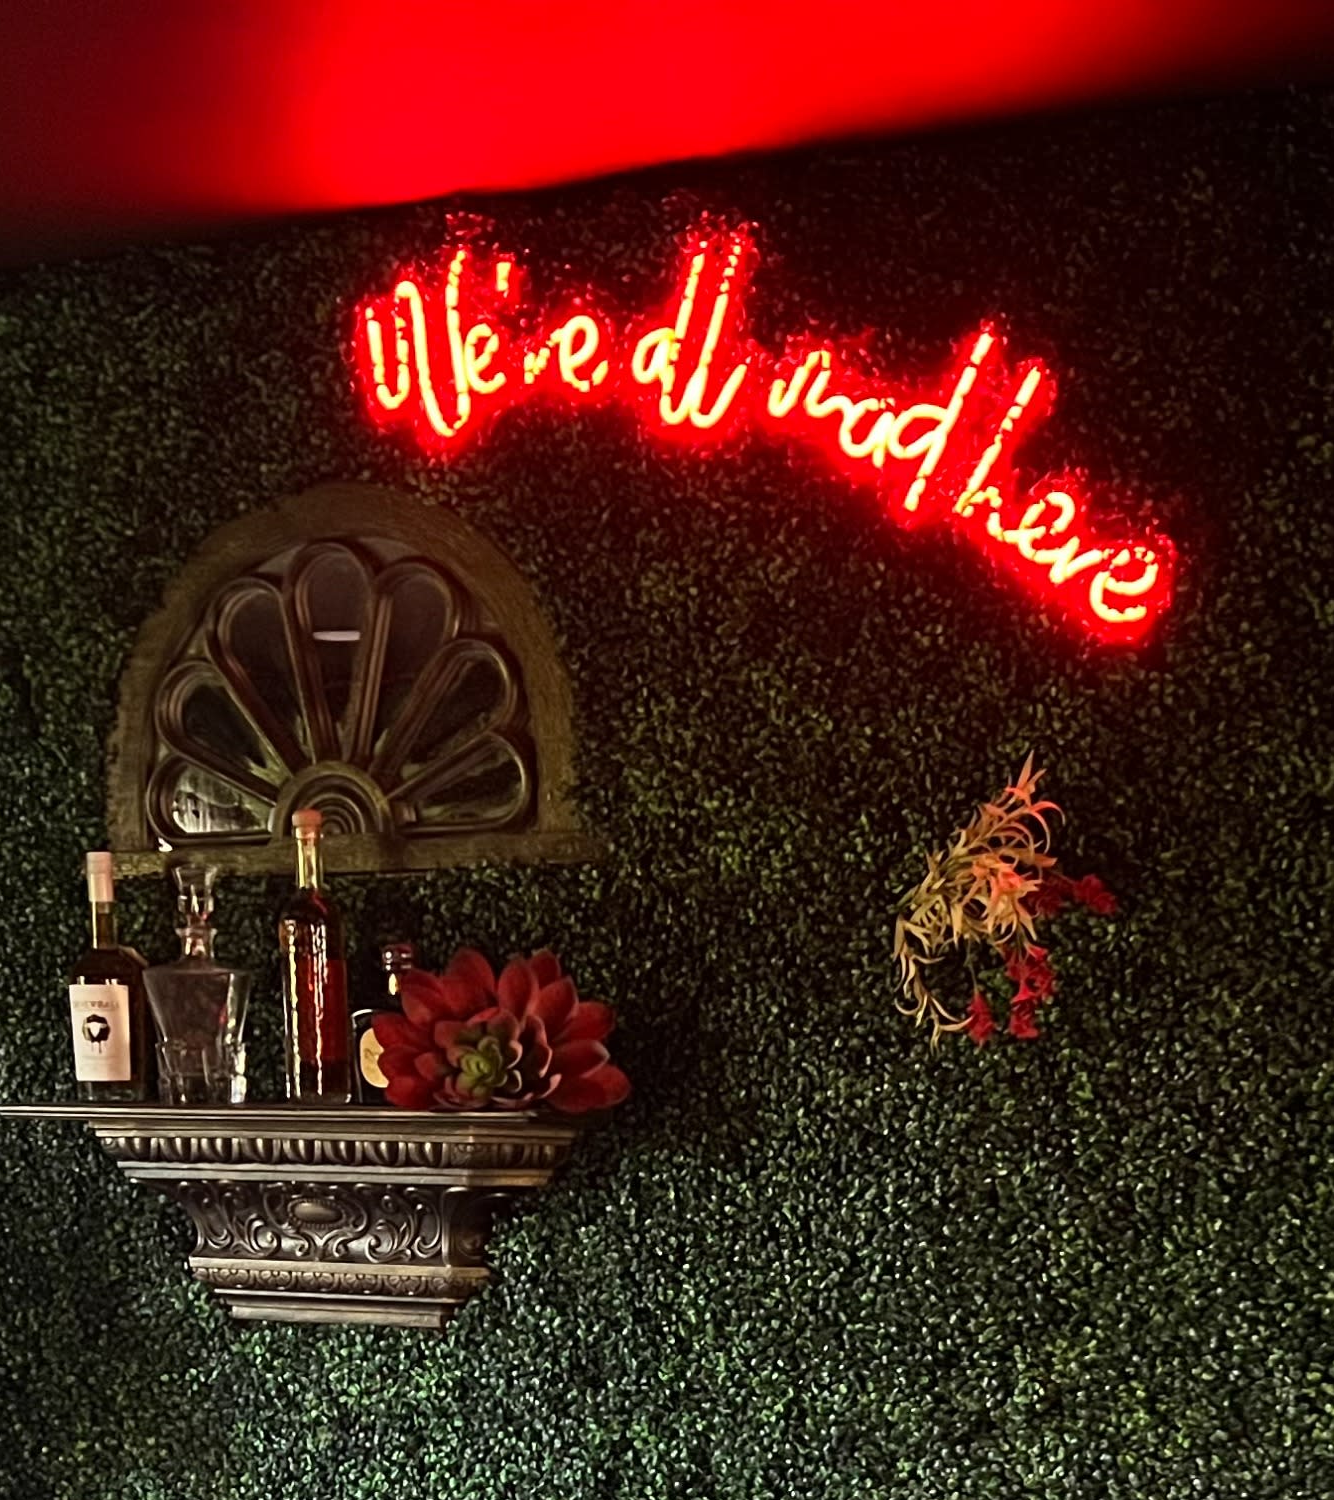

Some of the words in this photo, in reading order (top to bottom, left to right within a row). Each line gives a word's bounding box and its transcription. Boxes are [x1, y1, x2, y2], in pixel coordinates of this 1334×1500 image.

[364, 246, 610, 438] We're
[630, 236, 750, 430] all
[766, 330, 995, 512] mad
[954, 365, 1161, 623] here
